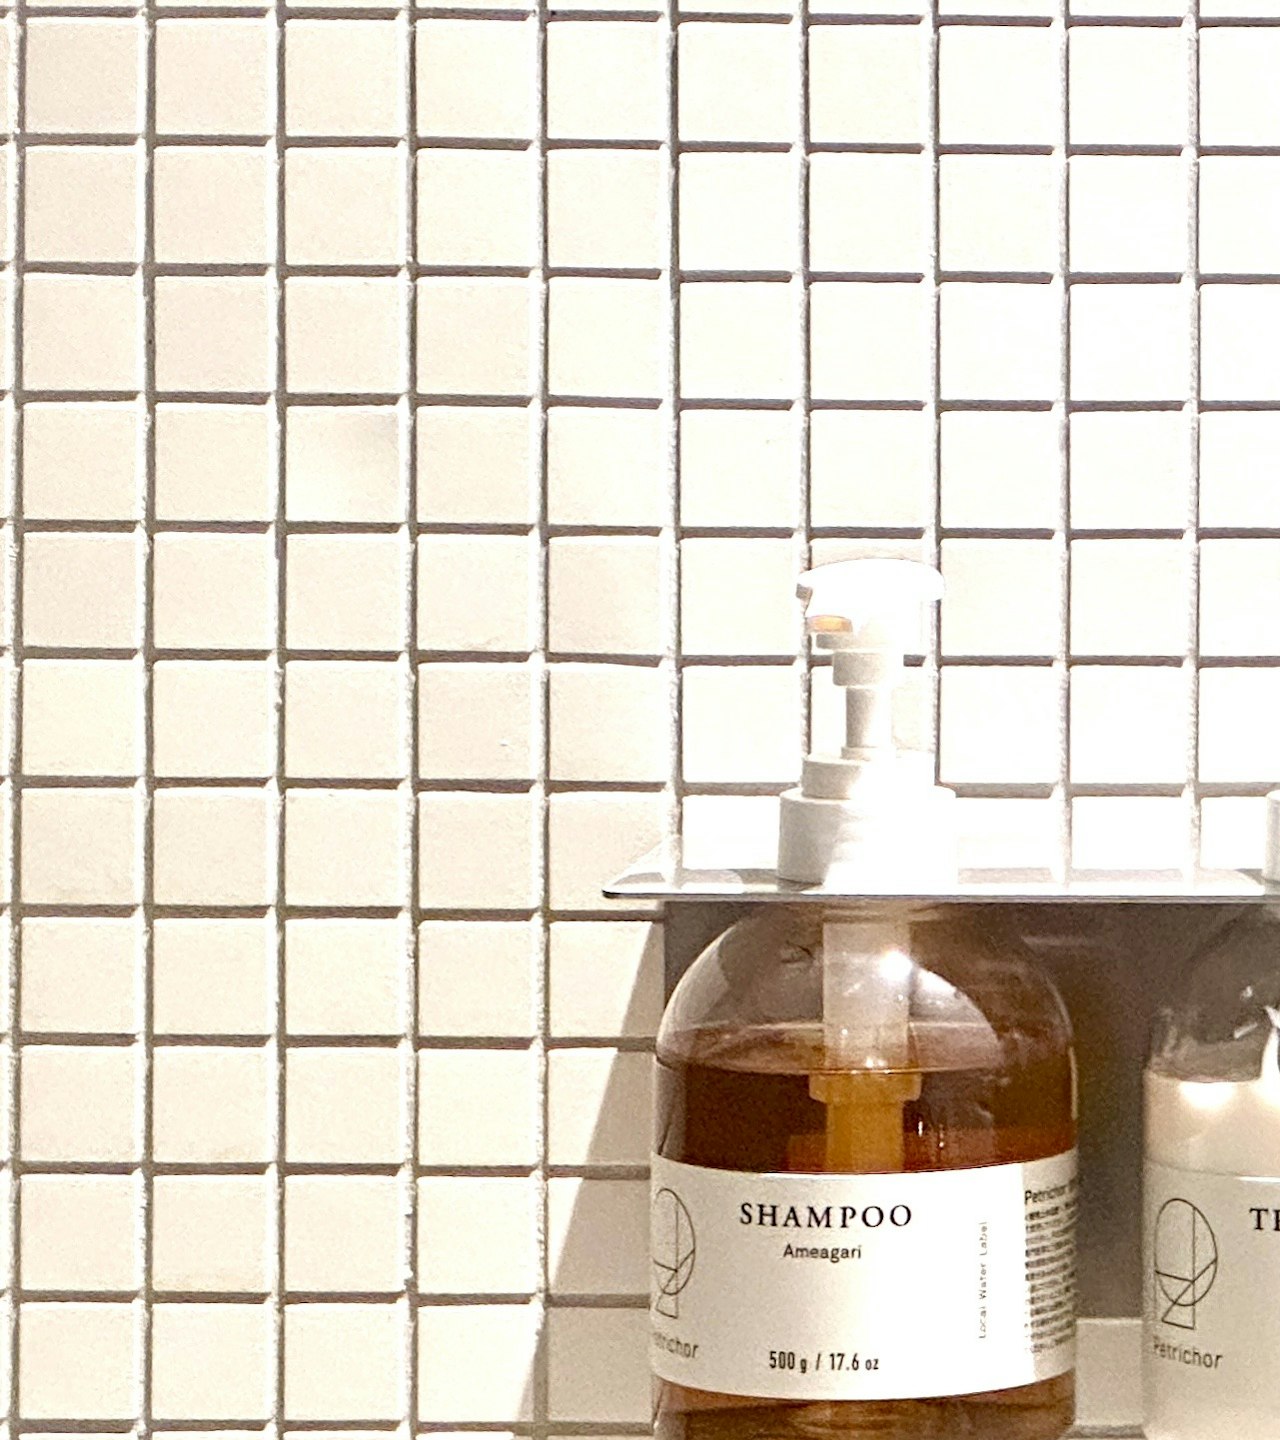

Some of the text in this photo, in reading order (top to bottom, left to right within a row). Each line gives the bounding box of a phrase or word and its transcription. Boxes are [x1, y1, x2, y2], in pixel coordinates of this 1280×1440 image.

[739, 1203, 912, 1229] SHAMPOO
[782, 1244, 862, 1263] Ameagari
[769, 1351, 879, 1373] 500 g / 17.6 oz
